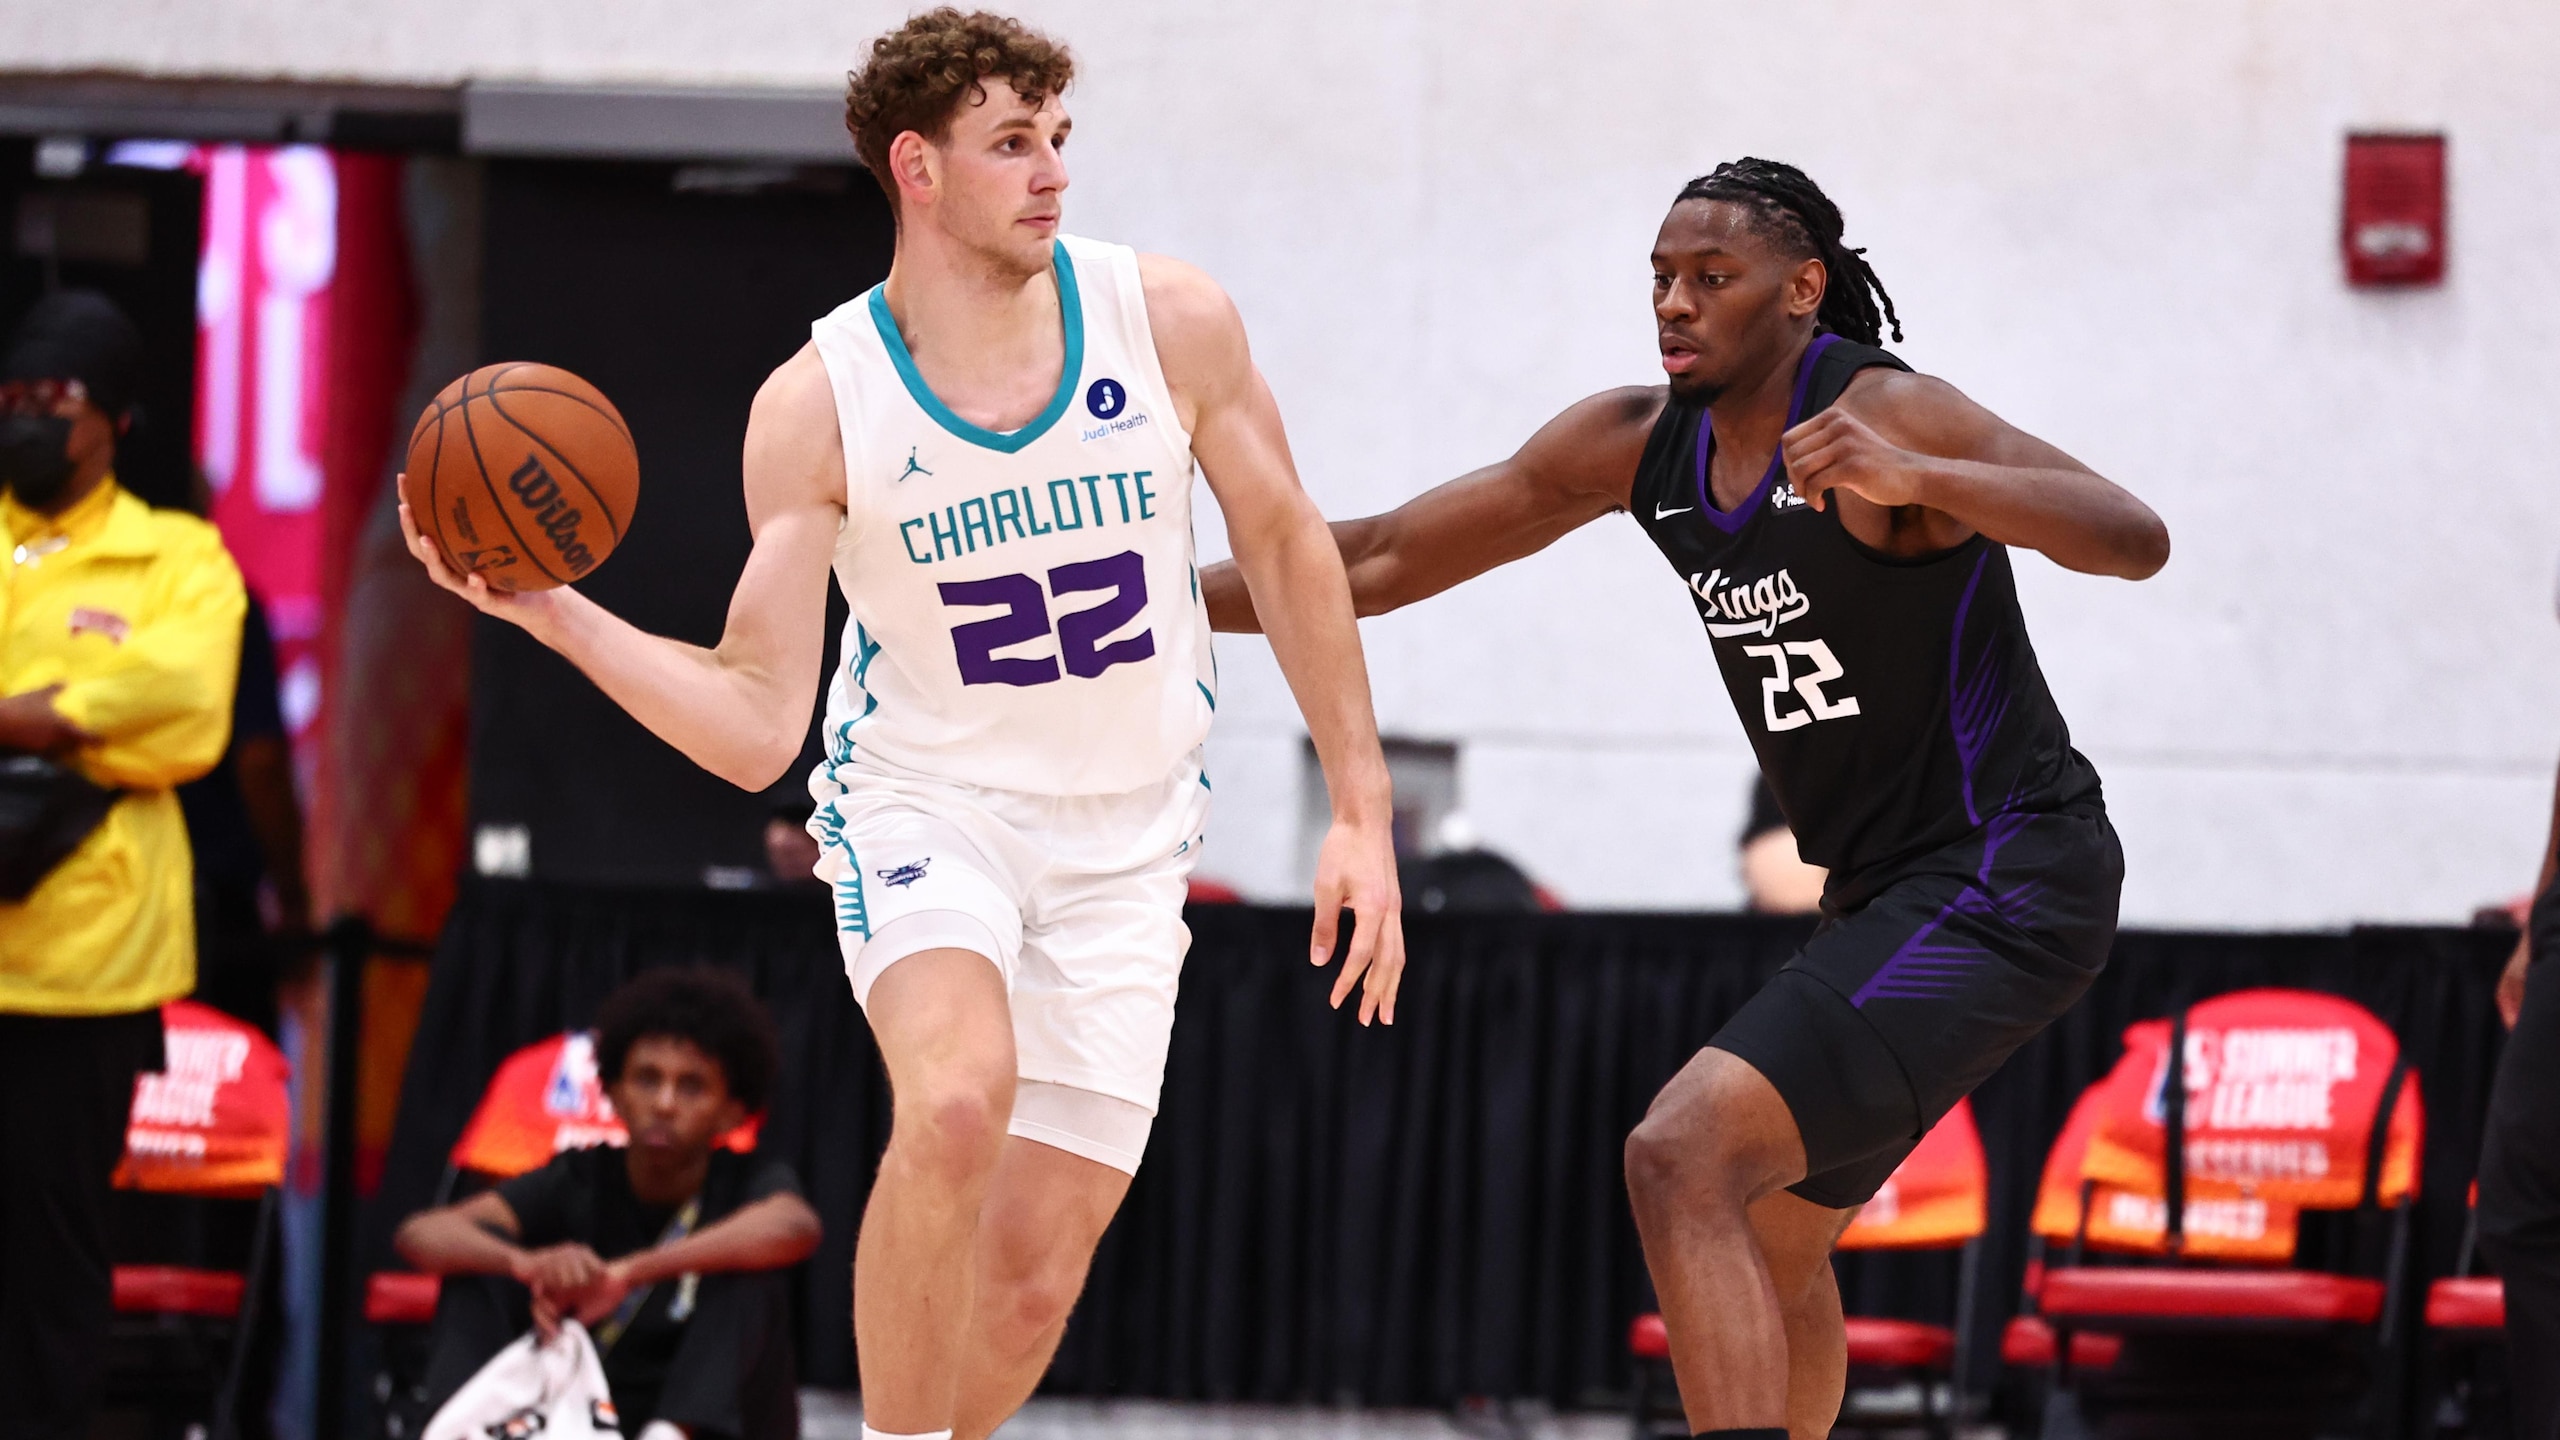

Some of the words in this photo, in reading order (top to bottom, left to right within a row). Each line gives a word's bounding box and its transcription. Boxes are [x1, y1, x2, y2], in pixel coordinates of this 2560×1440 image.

[1081, 424, 1110, 442] Judi
[1110, 412, 1148, 434] Health
[509, 452, 597, 576] Wilson
[900, 471, 1157, 564] CHARLOTTE
[936, 550, 1156, 687] 22
[1742, 638, 1861, 732] 22
